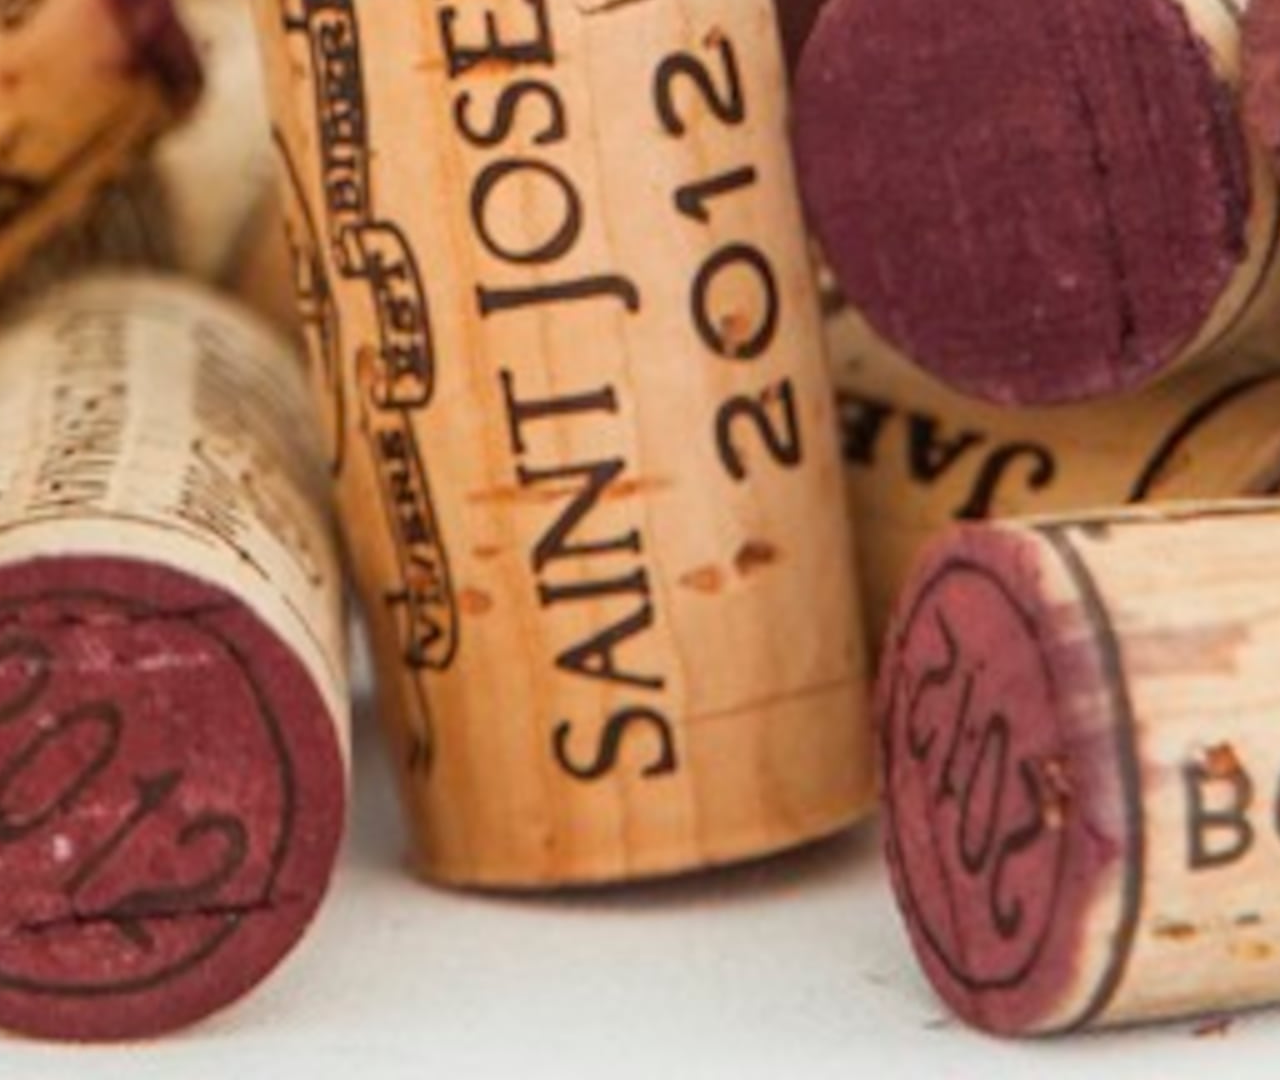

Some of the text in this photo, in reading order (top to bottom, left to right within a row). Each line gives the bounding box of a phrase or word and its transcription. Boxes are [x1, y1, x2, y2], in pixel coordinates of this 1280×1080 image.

[654, 36, 802, 482] 2012
[498, 370, 676, 781] SAINT
[906, 608, 1052, 939] 2012
